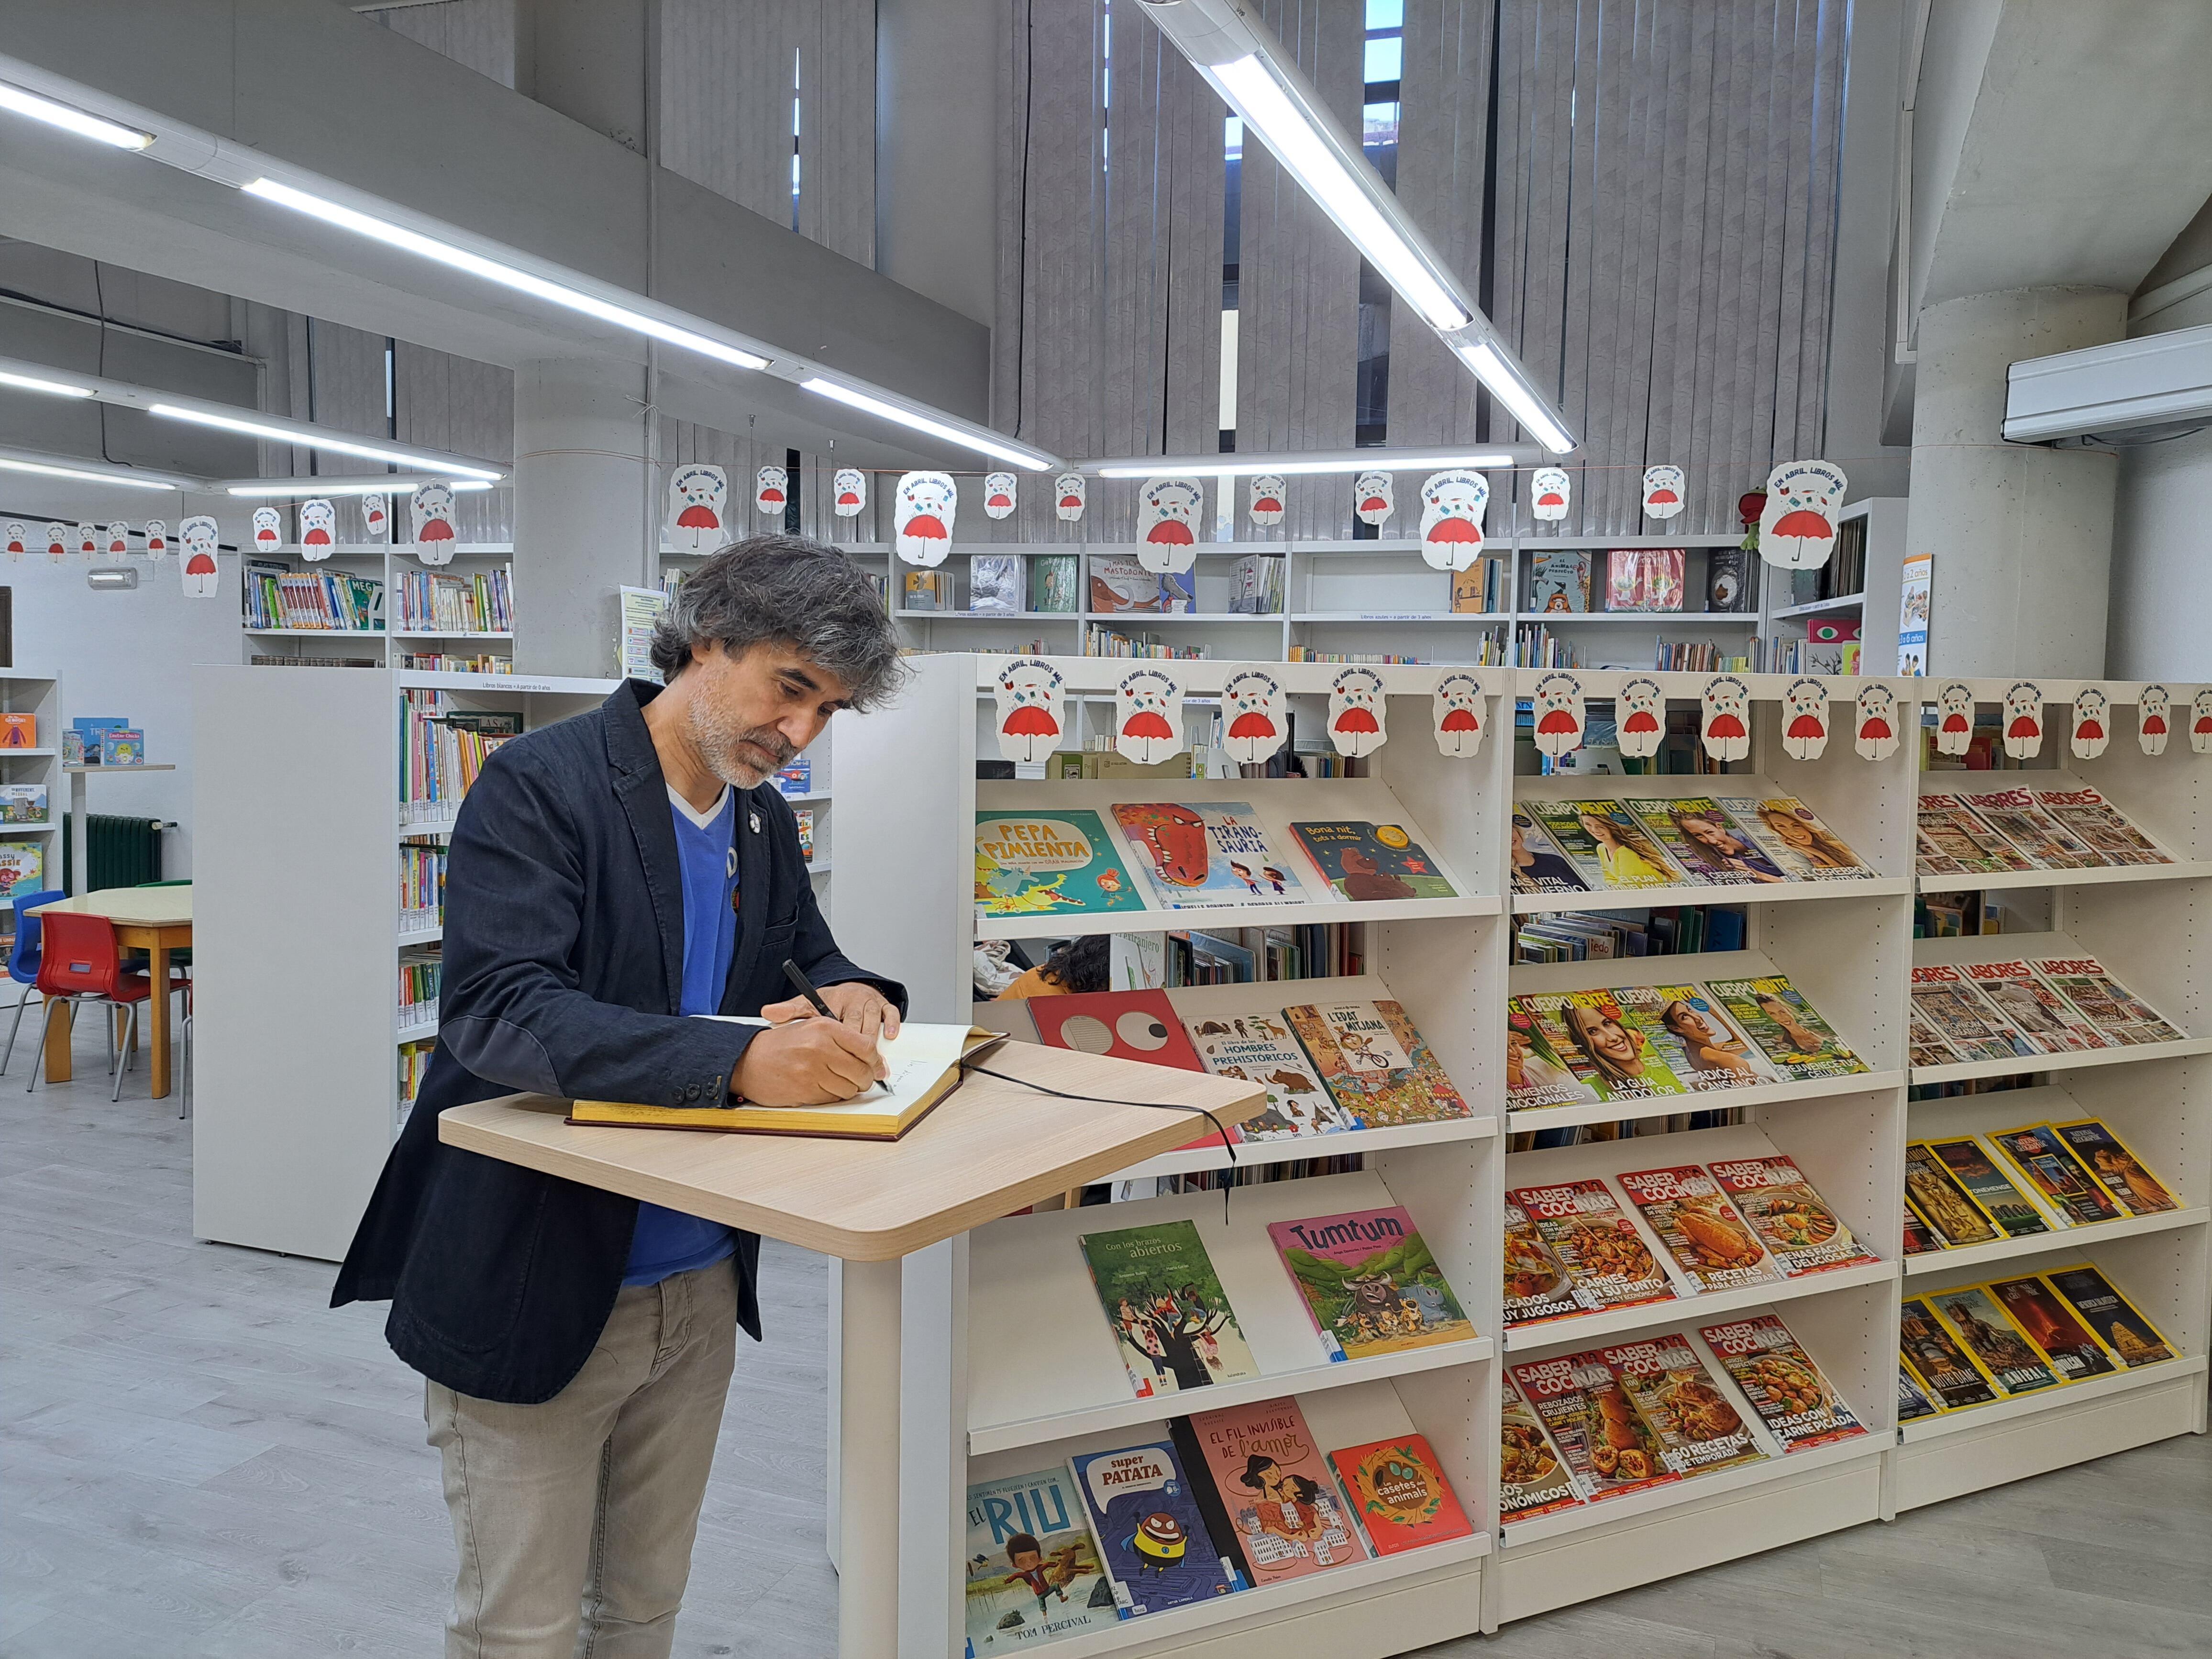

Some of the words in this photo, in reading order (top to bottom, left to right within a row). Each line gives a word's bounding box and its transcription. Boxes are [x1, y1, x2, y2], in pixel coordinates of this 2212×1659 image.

[675, 478, 684, 487] EN
[699, 469, 718, 481] LIBROS
[716, 479, 725, 489] MIL
[1774, 477, 1785, 488] EN
[1809, 467, 1835, 481] LIBROS
[1832, 479, 1844, 491] MIL
[903, 486, 911, 495] EN
[928, 477, 948, 490] LIBROS
[945, 488, 954, 499] MIL
[1147, 490, 1155, 500] EN
[1174, 481, 1194, 493] LIBROS
[1192, 491, 1202, 502] MIL
[1910, 569, 1914, 578] 2
[1914, 568, 1928, 578] años
[1906, 634, 1910, 643] 6
[1911, 634, 1924, 642] años
[998, 671, 1008, 683] EN
[1029, 659, 1054, 674] LIBROS
[1052, 671, 1063, 685] MIL
[1333, 677, 1341, 687] EN
[1357, 667, 1377, 680] LIBROS
[1375, 677, 1384, 689] MIL
[1120, 679, 1128, 689] EN
[1148, 669, 1170, 683] LIBROS
[1168, 681, 1178, 693] MIL
[1535, 683, 1542, 692] EN
[1558, 672, 1575, 683] LIBROS
[1573, 681, 1582, 692] MIL
[1628, 798, 1717, 813] CUERPOMENTE
[1963, 788, 2034, 810] LABORES
[2036, 788, 2103, 807] LABORES
[1532, 801, 1623, 815] CUERPOMENTE
[1223, 816, 1238, 826] LA
[999, 824, 1058, 841] PEPA
[1207, 826, 1262, 840] TIRANO-
[1305, 826, 1335, 835] Bona
[1336, 826, 1356, 835] nit,
[983, 841, 1090, 859] PIMIENTA
[1217, 840, 1269, 853] SAURIA
[1709, 871, 1758, 879] CEREBRO
[1813, 867, 1866, 876] CEREBRO
[1534, 876, 1569, 885] VITAL
[1961, 961, 2032, 981] LABORES
[2035, 959, 2105, 975] LABORES
[1614, 985, 1701, 1005] CUERPOMENTE
[1710, 977, 1792, 997] CUERPOMENTE
[1521, 992, 1613, 1013] CUERPOMENTE
[1327, 1011, 1358, 1022] L'EDAT
[1345, 1019, 1386, 1031] MITJANA
[1224, 1044, 1277, 1054] HOMBRES
[1212, 1052, 1298, 1066] PREHISTÓRICOS
[1784, 1060, 1840, 1073] REJUVENECE
[1697, 1068, 1734, 1081] ADIÓS
[1808, 1068, 1850, 1079] CÉLULAS
[1506, 1083, 1569, 1099] ALIMENTOS
[1609, 1080, 1625, 1091] LA
[1626, 1076, 1659, 1088] GUÍA
[1697, 1076, 1770, 1091] CANSANCIO
[1606, 1085, 1678, 1102] ANTIDOLOR
[1713, 1161, 1766, 1177] SABER
[1623, 1172, 1679, 1190] SABER
[1731, 1169, 1804, 1189] COCINAR
[1520, 1187, 1573, 1205] SABER
[1642, 1180, 1719, 1201] COCINAR
[1539, 1196, 1616, 1217] COCINAR
[1737, 1196, 1768, 1205] PERFECTO
[1290, 1217, 1405, 1250] Tumtum
[1106, 1242, 1121, 1251] Con
[1122, 1241, 1135, 1249] los
[1135, 1237, 1161, 1248] brazos
[1129, 1241, 1183, 1259] abiertos
[1814, 1241, 1858, 1257] FÁCILES
[1792, 1249, 1857, 1268] DELICIOSAS
[1578, 1272, 1628, 1289] CARNES
[1708, 1266, 1762, 1281] RECETAS
[1729, 1273, 1775, 1288] CELEBRAR
[1622, 1278, 1665, 1293] PUNTO
[1521, 1299, 1577, 1318] JUGOSOS
[1703, 1322, 1756, 1343] SABER
[1721, 1329, 1793, 1355] COCINAR
[1604, 1343, 1658, 1365] SABER
[1516, 1360, 1574, 1383] SABER
[1623, 1350, 1697, 1376] COCINAR
[1727, 1360, 1756, 1369] PERFECTO
[1536, 1367, 1614, 1395] COCINAR
[1929, 1371, 1958, 1389] NOTRE
[1953, 1368, 1980, 1384] DAME
[2004, 1366, 2047, 1385] ANÍBAL
[1537, 1395, 1584, 1411] REBOZADOS
[1541, 1402, 1587, 1417] CRUJIENTES
[1767, 1416, 1797, 1430] IDEAS
[1797, 1408, 1825, 1424] CON
[1815, 1414, 1857, 1432] PICADA
[1209, 1430, 1225, 1445] EL
[1226, 1426, 1245, 1442] FIL
[1246, 1415, 1296, 1436] INVISIBLE
[1691, 1432, 1750, 1455] RECETAS
[1222, 1446, 1236, 1459] DE
[1691, 1448, 1740, 1465] TEMPORADA
[1110, 1454, 1144, 1469] super
[1102, 1462, 1163, 1486] PATATA
[973, 1488, 1002, 1499] SENTIMENTS
[1003, 1484, 1024, 1493] FLUEIXEN
[1028, 1479, 1047, 1488] CANVIEN
[1377, 1480, 1416, 1496] casetes
[1387, 1487, 1428, 1504] animals
[968, 1506, 986, 1527] EL
[982, 1484, 1071, 1545] RIU
[1014, 1626, 1038, 1641] TOM
[1041, 1615, 1092, 1635] PERCIVAL
